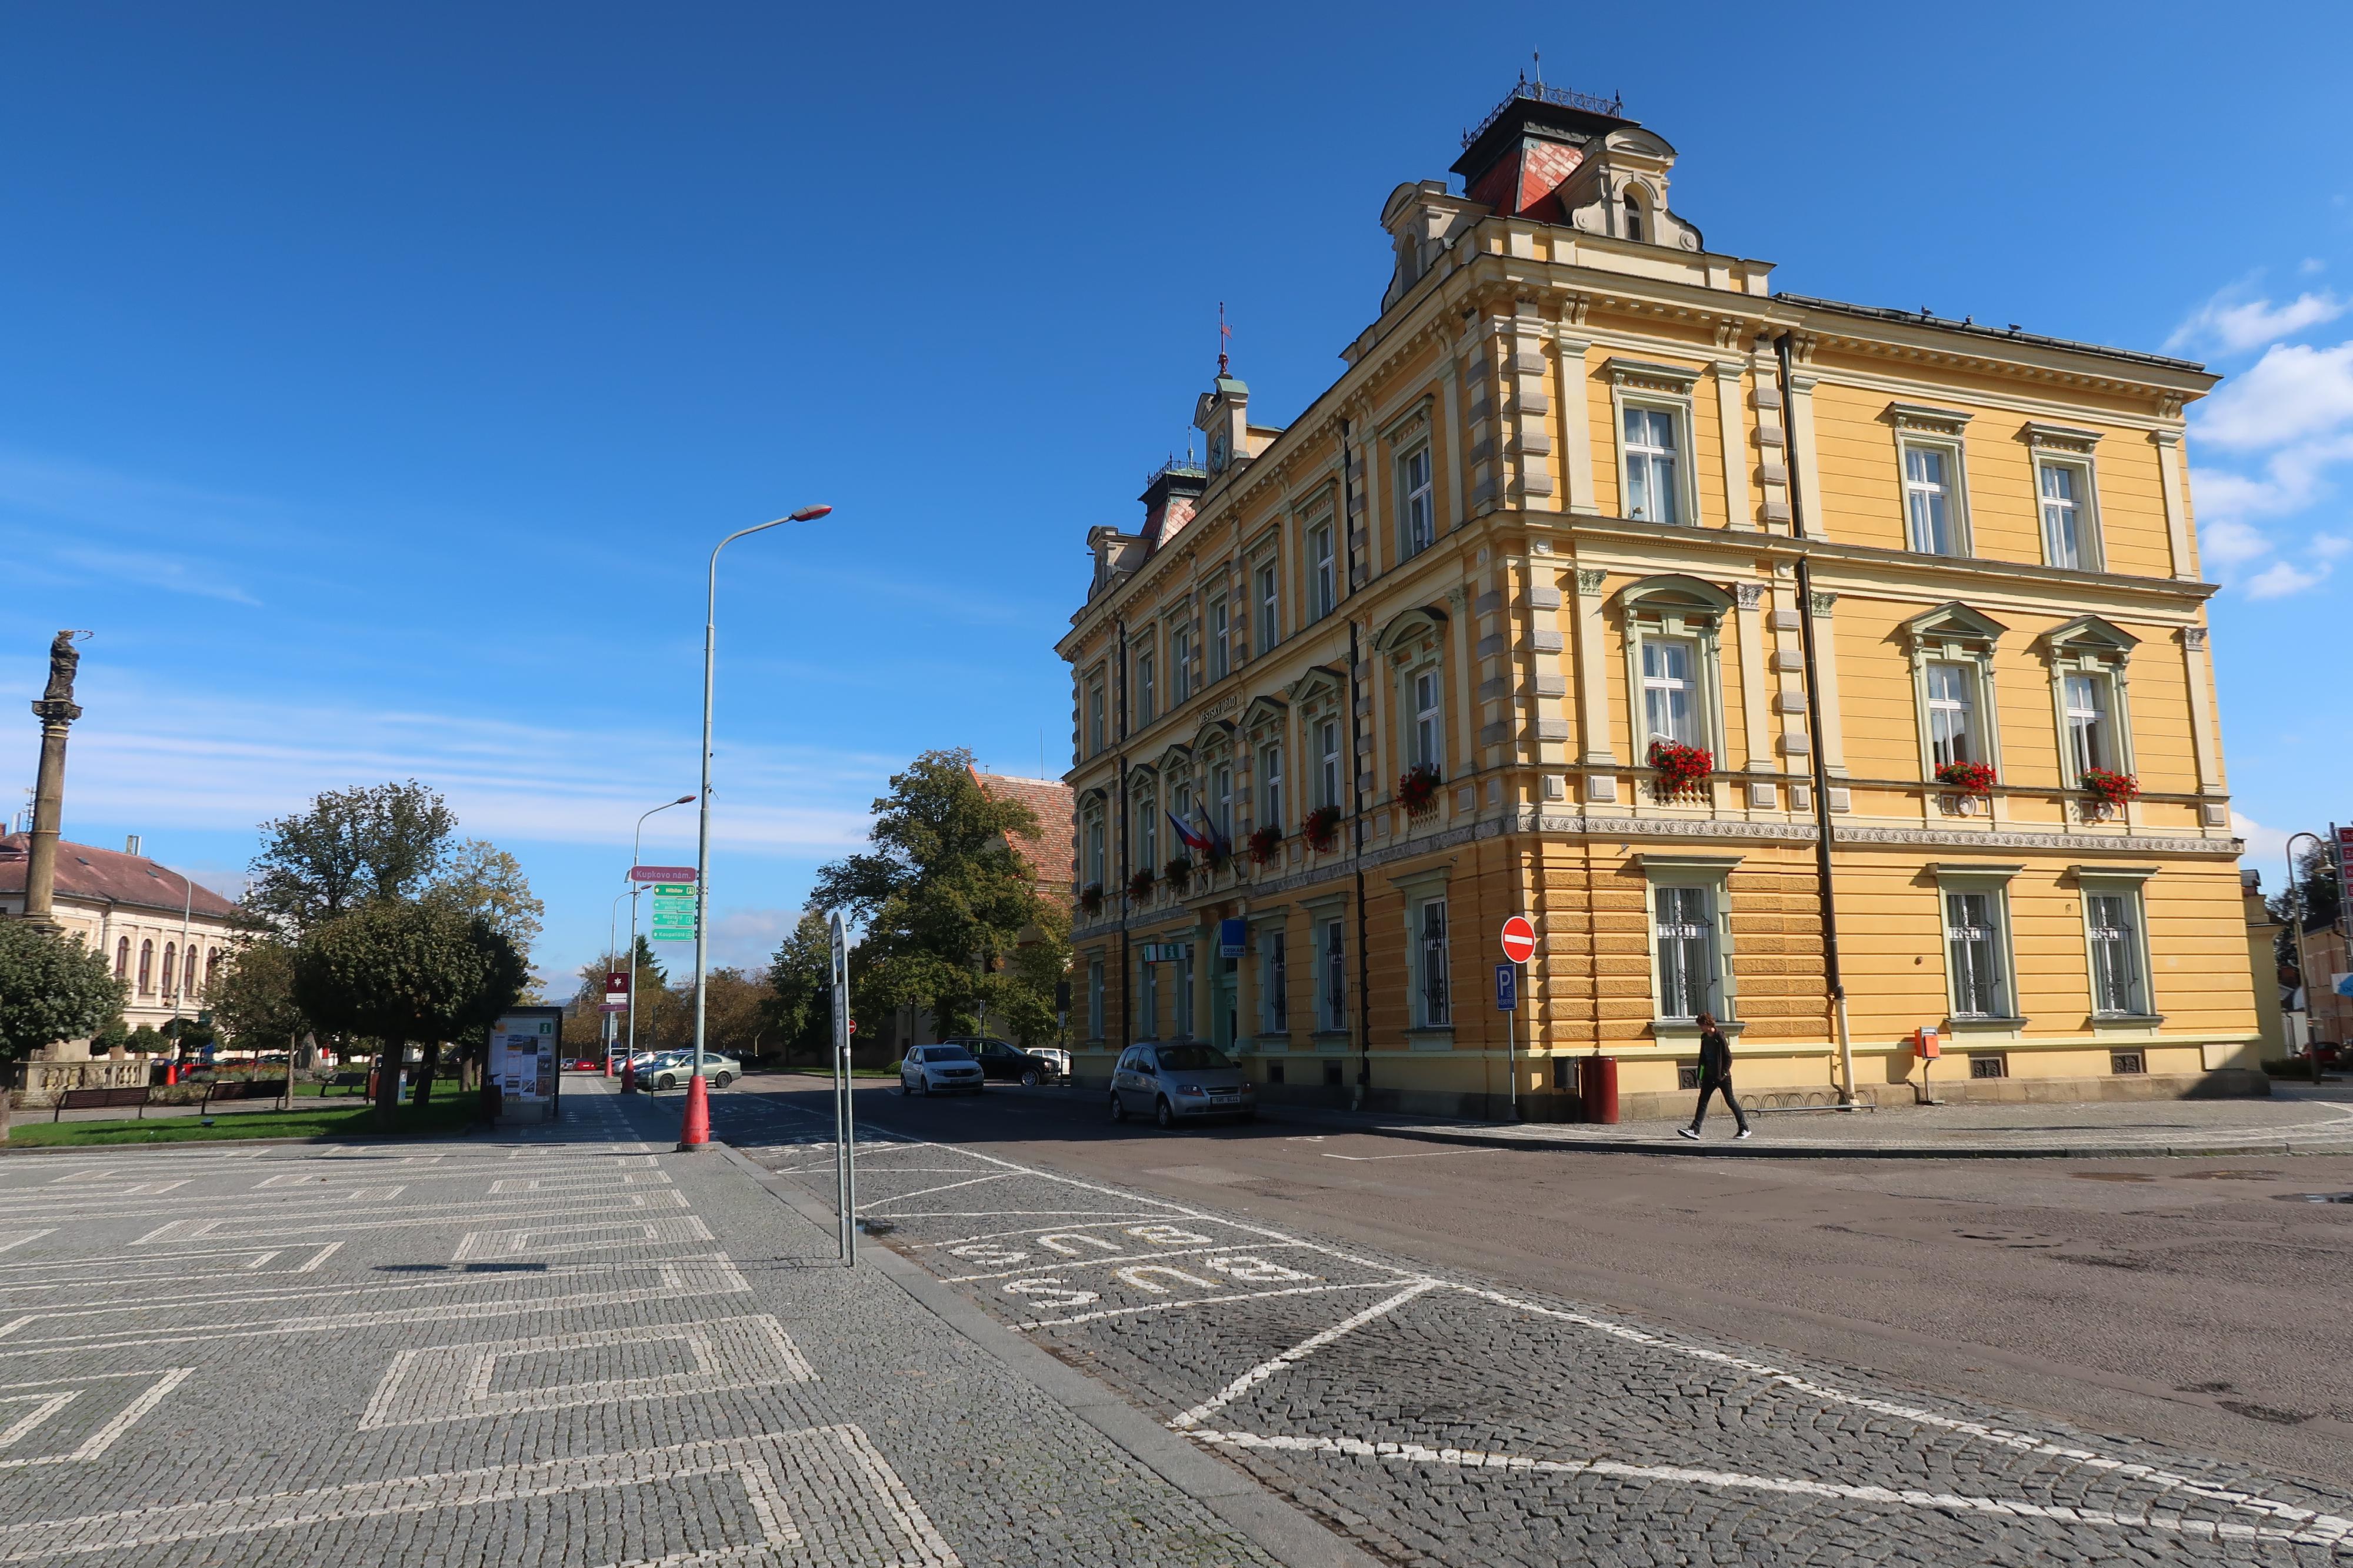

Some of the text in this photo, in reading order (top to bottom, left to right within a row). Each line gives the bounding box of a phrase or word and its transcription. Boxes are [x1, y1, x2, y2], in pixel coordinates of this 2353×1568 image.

[636, 870, 671, 879] Kupkovo
[1499, 970, 1511, 996] P
[948, 1225, 1213, 1265] BUS
[1001, 1256, 1318, 1309] BUS
